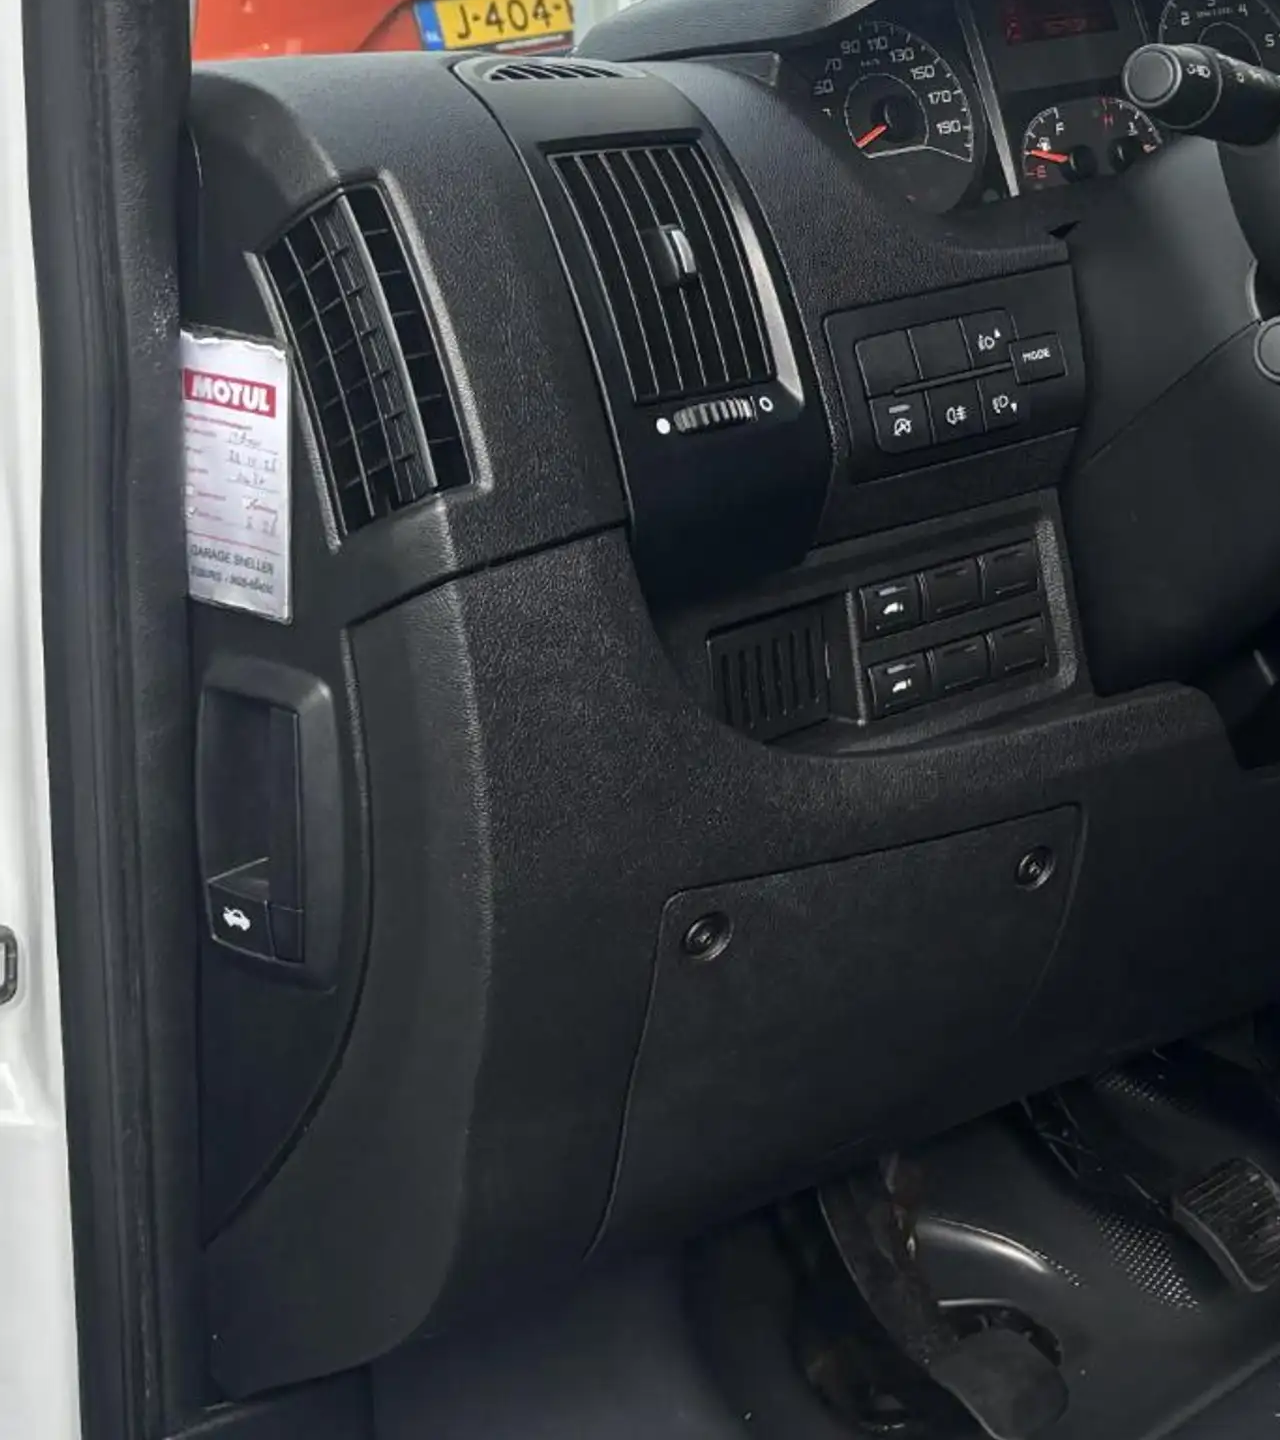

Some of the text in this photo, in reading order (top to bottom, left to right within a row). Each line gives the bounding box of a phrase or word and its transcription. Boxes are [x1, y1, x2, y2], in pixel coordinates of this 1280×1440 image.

[1180, 11, 1191, 26] 2
[840, 39, 861, 56] 90
[1264, 33, 1275, 48] 5
[887, 46, 915, 64] 130
[909, 64, 936, 81] 150
[927, 89, 952, 106] 170
[1054, 121, 1065, 136] F
[1021, 347, 1051, 363] MODE
[191, 374, 271, 413] MOTUL
